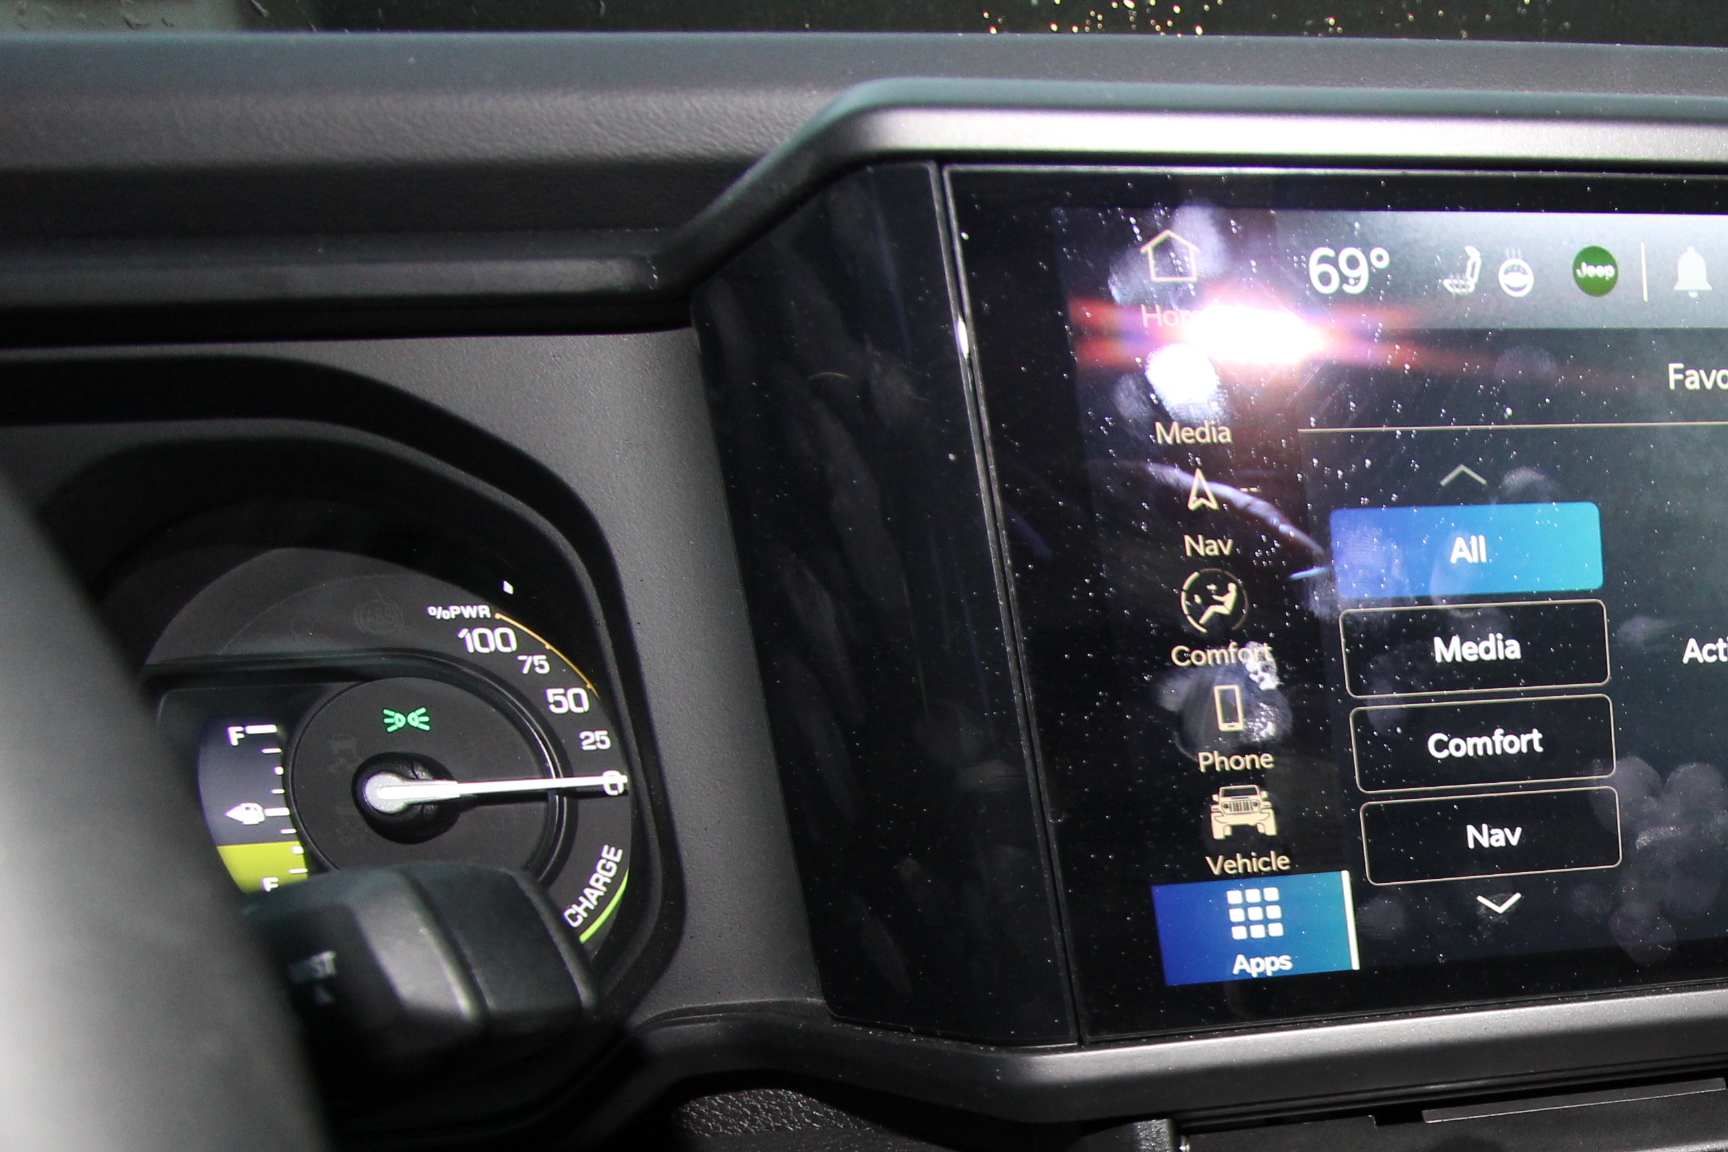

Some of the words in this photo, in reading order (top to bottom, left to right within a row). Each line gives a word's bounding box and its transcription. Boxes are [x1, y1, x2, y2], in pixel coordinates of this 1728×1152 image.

[1308, 247, 1390, 295] 69°
[1576, 261, 1616, 280] Jeep
[1154, 419, 1233, 445] Media
[1184, 534, 1233, 558] Nav
[1450, 536, 1487, 564] All
[427, 604, 491, 622] %PWR
[457, 626, 518, 655] 100
[1171, 640, 1274, 667] Comfort
[1433, 636, 1522, 664] Media
[517, 654, 551, 675] 75
[547, 686, 590, 715] 50
[227, 726, 245, 747] F
[579, 730, 611, 751] 25
[1428, 728, 1544, 759] Comfort
[1199, 749, 1275, 772] Phone
[1467, 823, 1522, 849] Nav
[1205, 851, 1291, 876] Vehicle
[562, 843, 624, 930] CHARGE
[1232, 952, 1293, 979] Apps
